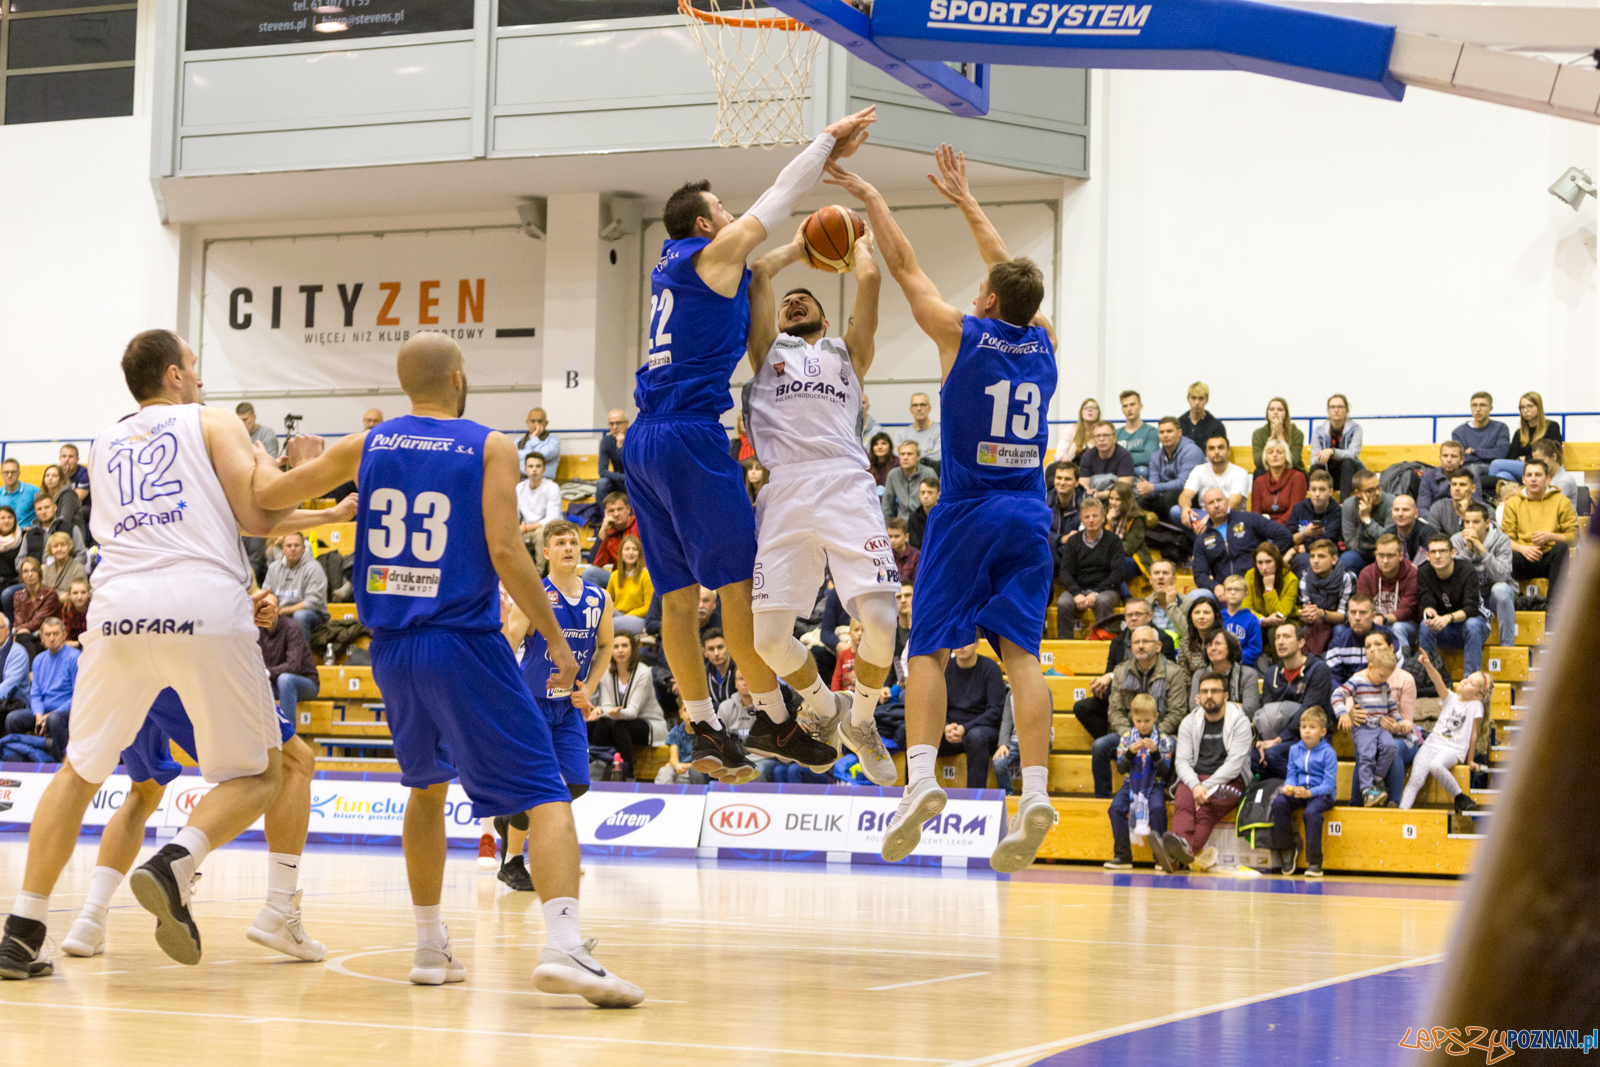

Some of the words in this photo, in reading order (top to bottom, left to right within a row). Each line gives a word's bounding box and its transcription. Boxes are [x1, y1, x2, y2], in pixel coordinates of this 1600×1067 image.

[258, 17, 306, 33] stevens.pl
[928, 0, 1026, 24] SPORT
[1026, 4, 1152, 34] SYSTEM
[229, 278, 485, 330] CITYZEN
[304, 331, 346, 345] WIĘCEJ
[352, 330, 372, 342] NIŻ
[378, 329, 410, 342] KLUB
[416, 327, 484, 339] TOWY
[803, 356, 821, 377] 6
[565, 370, 579, 389] B
[776, 380, 846, 403] BIOFARM
[984, 379, 1041, 439] 13
[368, 433, 455, 452] Polfarmex
[998, 448, 1038, 458] drukarnia
[107, 432, 183, 506] 12
[368, 488, 451, 562] 33
[583, 607, 601, 628] 10
[1042, 654, 1053, 663] 16
[1491, 660, 1498, 669] 9
[351, 681, 358, 689] 9
[1075, 690, 1085, 699] 15
[303, 714, 308, 722] 9
[944, 768, 954, 777] 16
[335, 796, 405, 814] funclu
[333, 812, 364, 820] biuro
[606, 811, 652, 828] atrem
[719, 811, 760, 829] KIA
[785, 813, 843, 832] DELIK
[857, 810, 987, 836] BIARM
[1330, 824, 1341, 833] 10
[1407, 826, 1413, 836] 9
